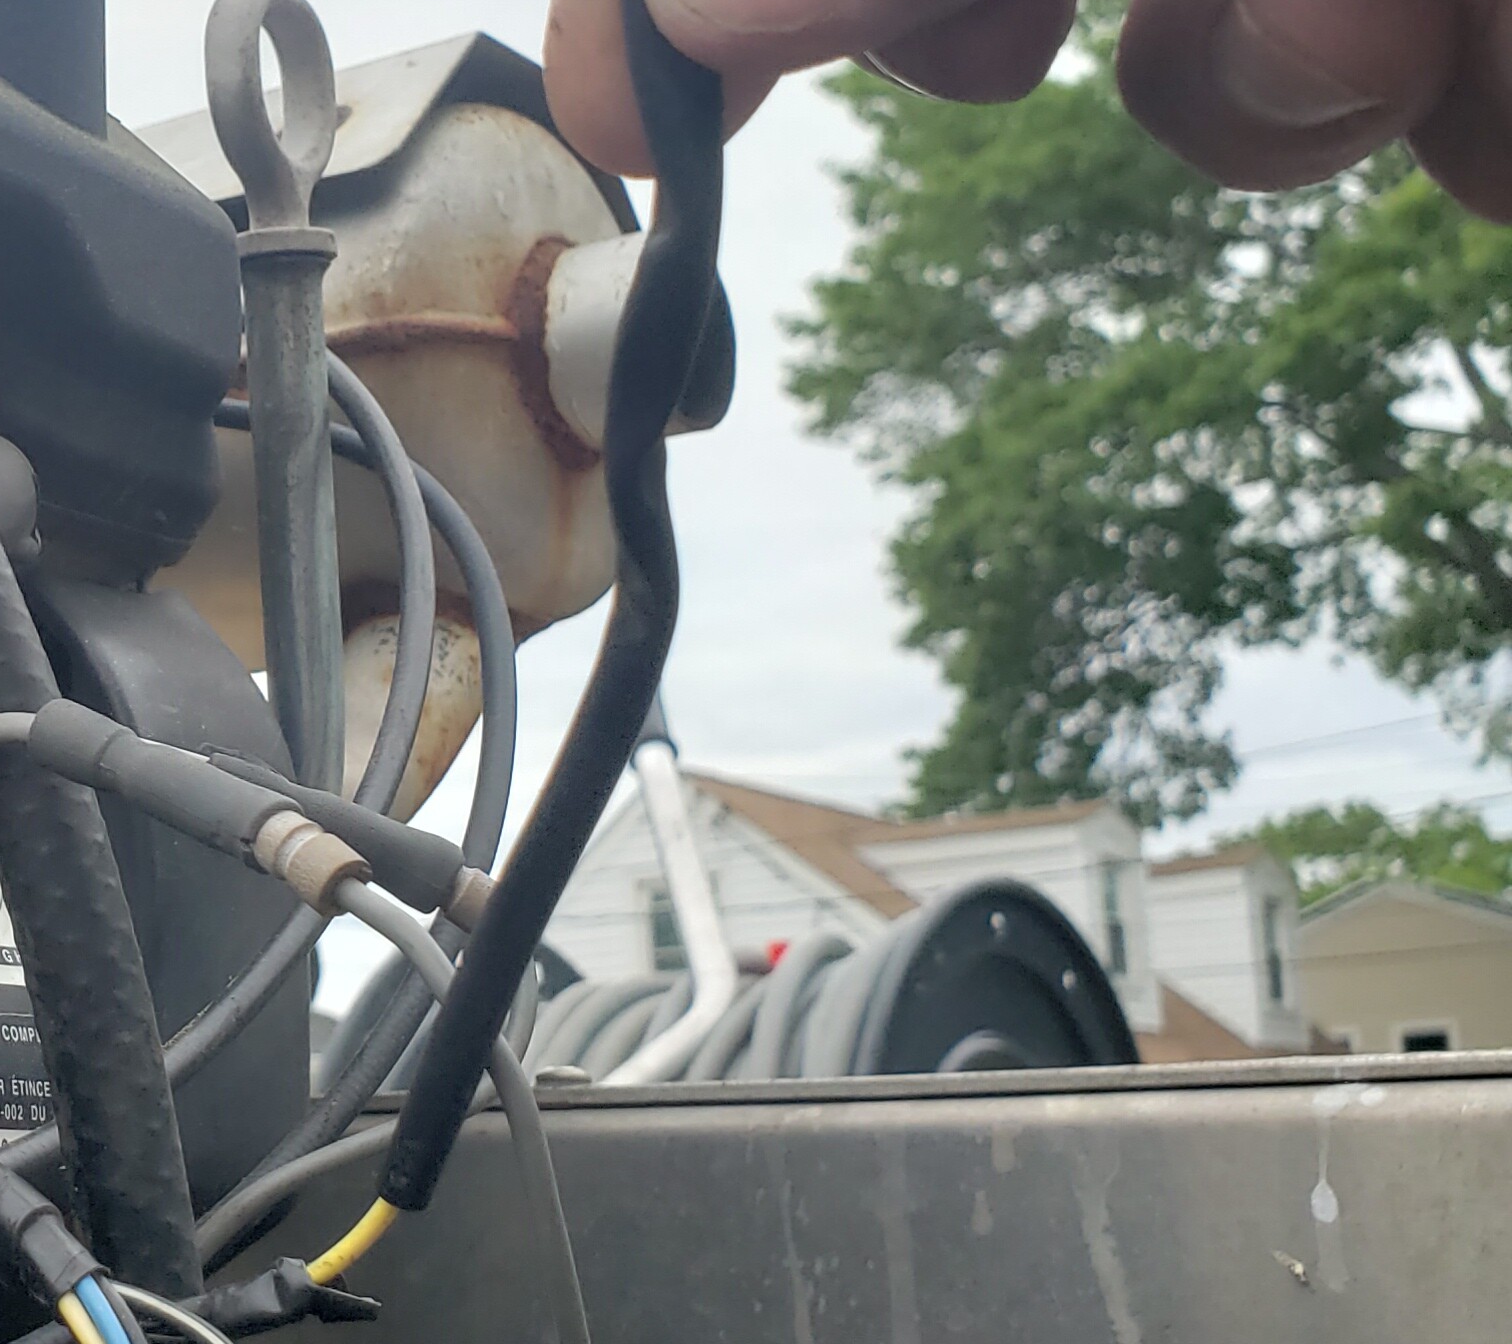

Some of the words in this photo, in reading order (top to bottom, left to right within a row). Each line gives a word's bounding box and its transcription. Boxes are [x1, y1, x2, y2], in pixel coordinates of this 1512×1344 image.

[1, 948, 14, 964] G
[11, 1074, 53, 1098] ÉTINCE
[30, 1104, 46, 1122] DU
